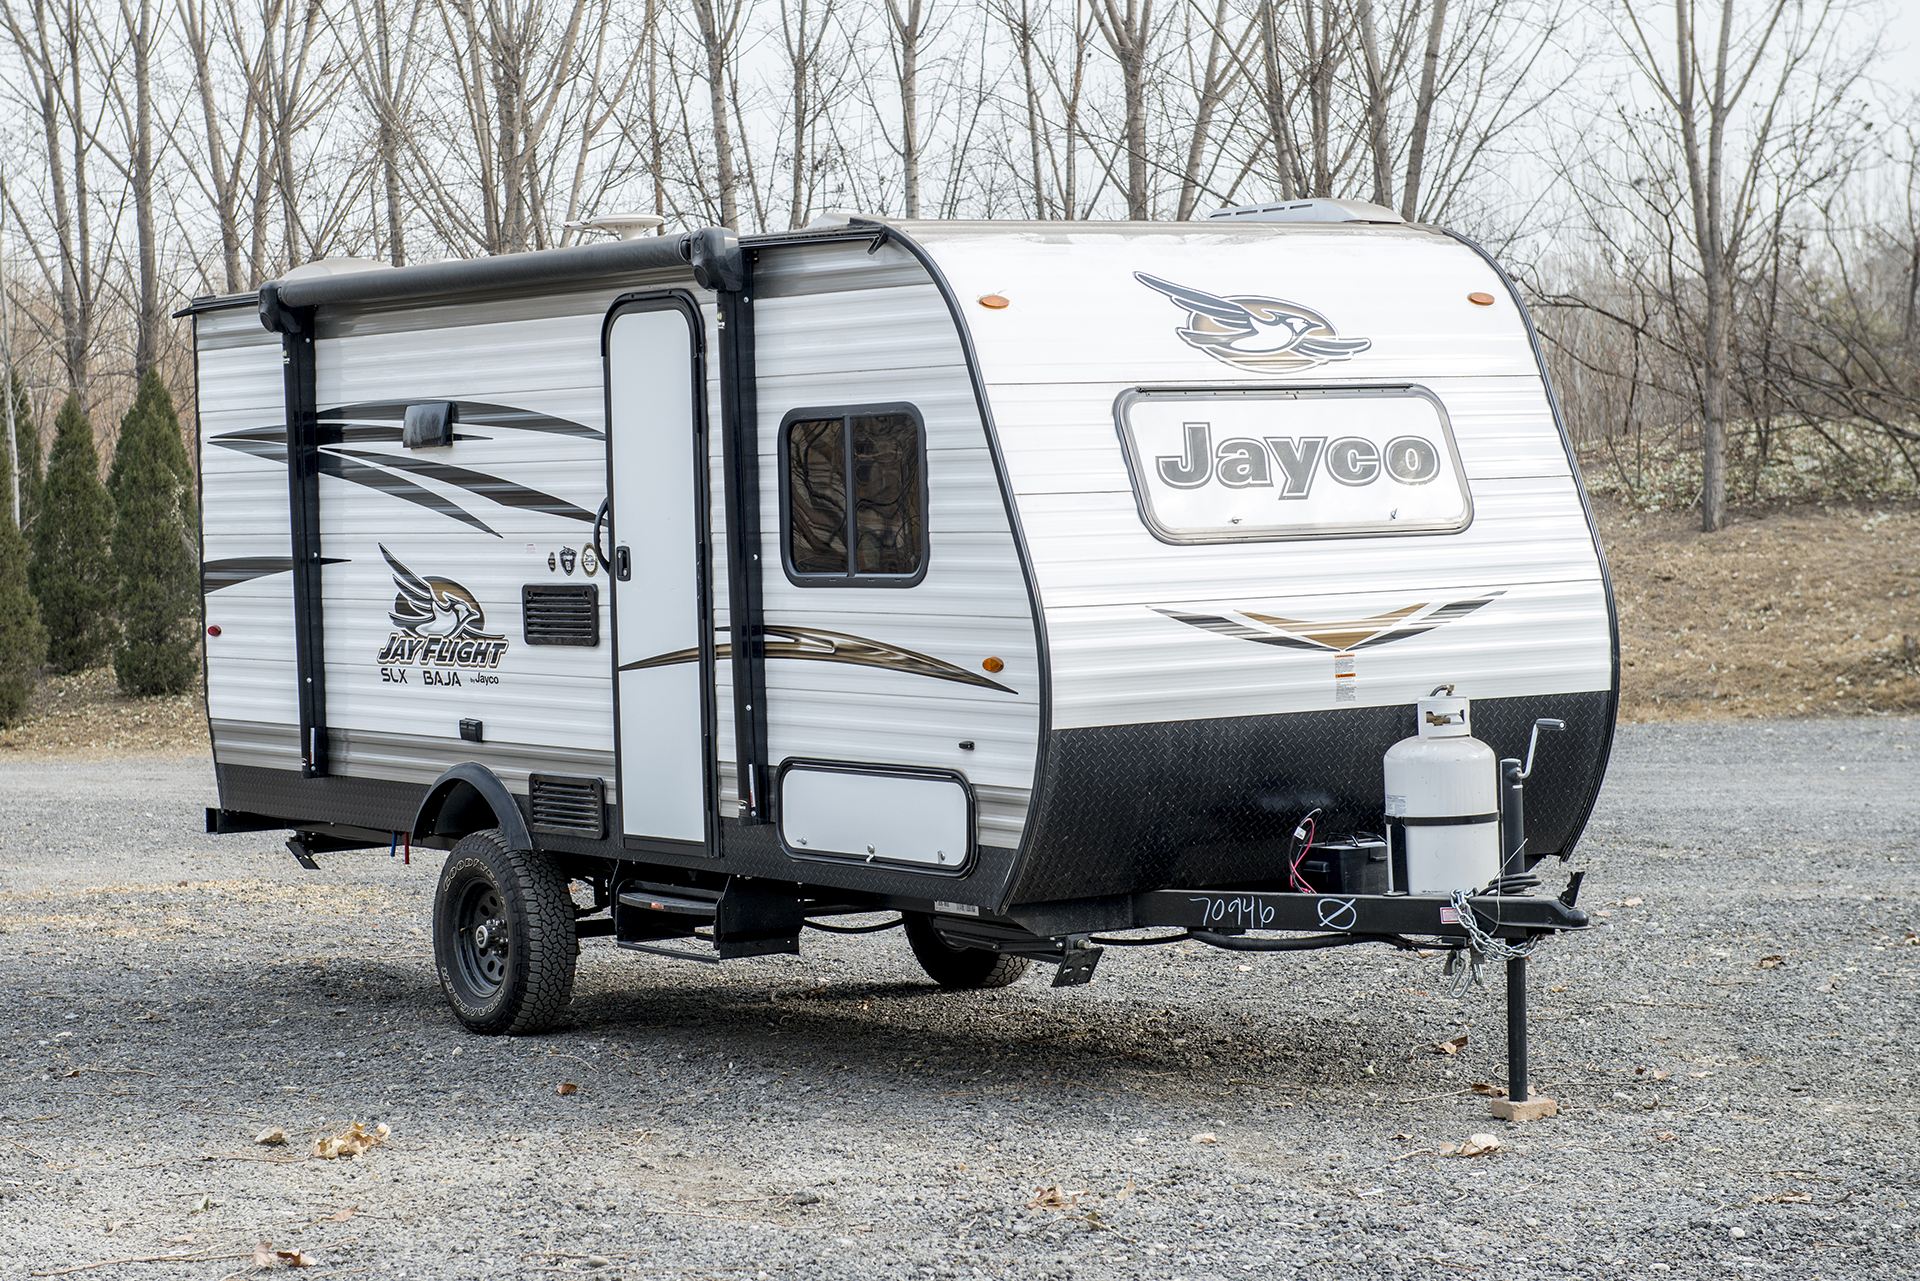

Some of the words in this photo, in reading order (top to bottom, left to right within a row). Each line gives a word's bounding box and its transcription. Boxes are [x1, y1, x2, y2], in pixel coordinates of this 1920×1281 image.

[1155, 422, 1440, 500] Jayco
[420, 634, 509, 668] FLIGHT
[381, 668, 408, 684] SLX
[423, 670, 462, 687] BAJA
[475, 672, 499, 686] Jayco
[1189, 896, 1275, 928] 70946
[441, 967, 505, 1017] WRANGLER
